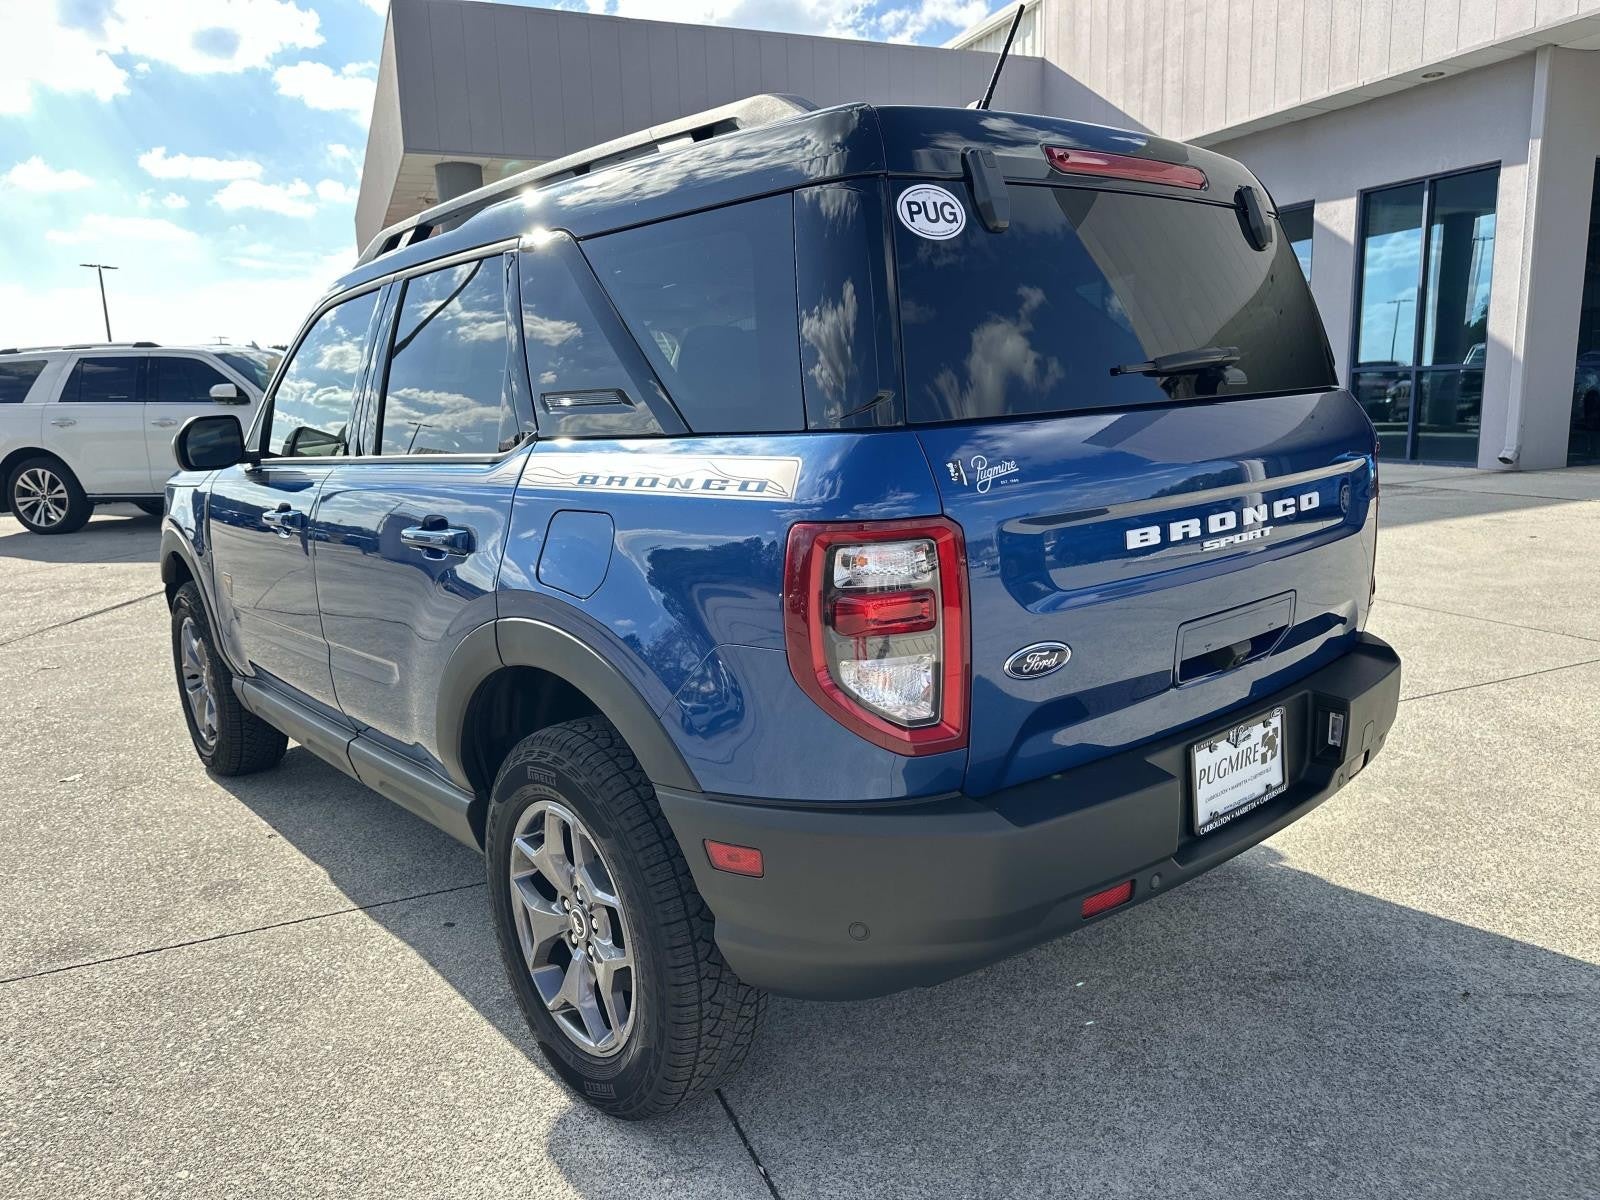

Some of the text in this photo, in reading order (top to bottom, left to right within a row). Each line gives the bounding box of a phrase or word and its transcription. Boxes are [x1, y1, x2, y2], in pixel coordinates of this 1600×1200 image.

[906, 200, 959, 224] PUG
[577, 474, 769, 493] BRONCO
[970, 455, 1020, 494] Pugmire
[1125, 491, 1320, 550] BRONCO
[1202, 526, 1273, 551] SPORT
[1022, 650, 1059, 673] Ford
[527, 765, 557, 787] PIRELLI
[1198, 742, 1260, 790] PUGMIRE
[1200, 814, 1231, 835] CARROLLTON
[1235, 801, 1257, 817] MARIETTA
